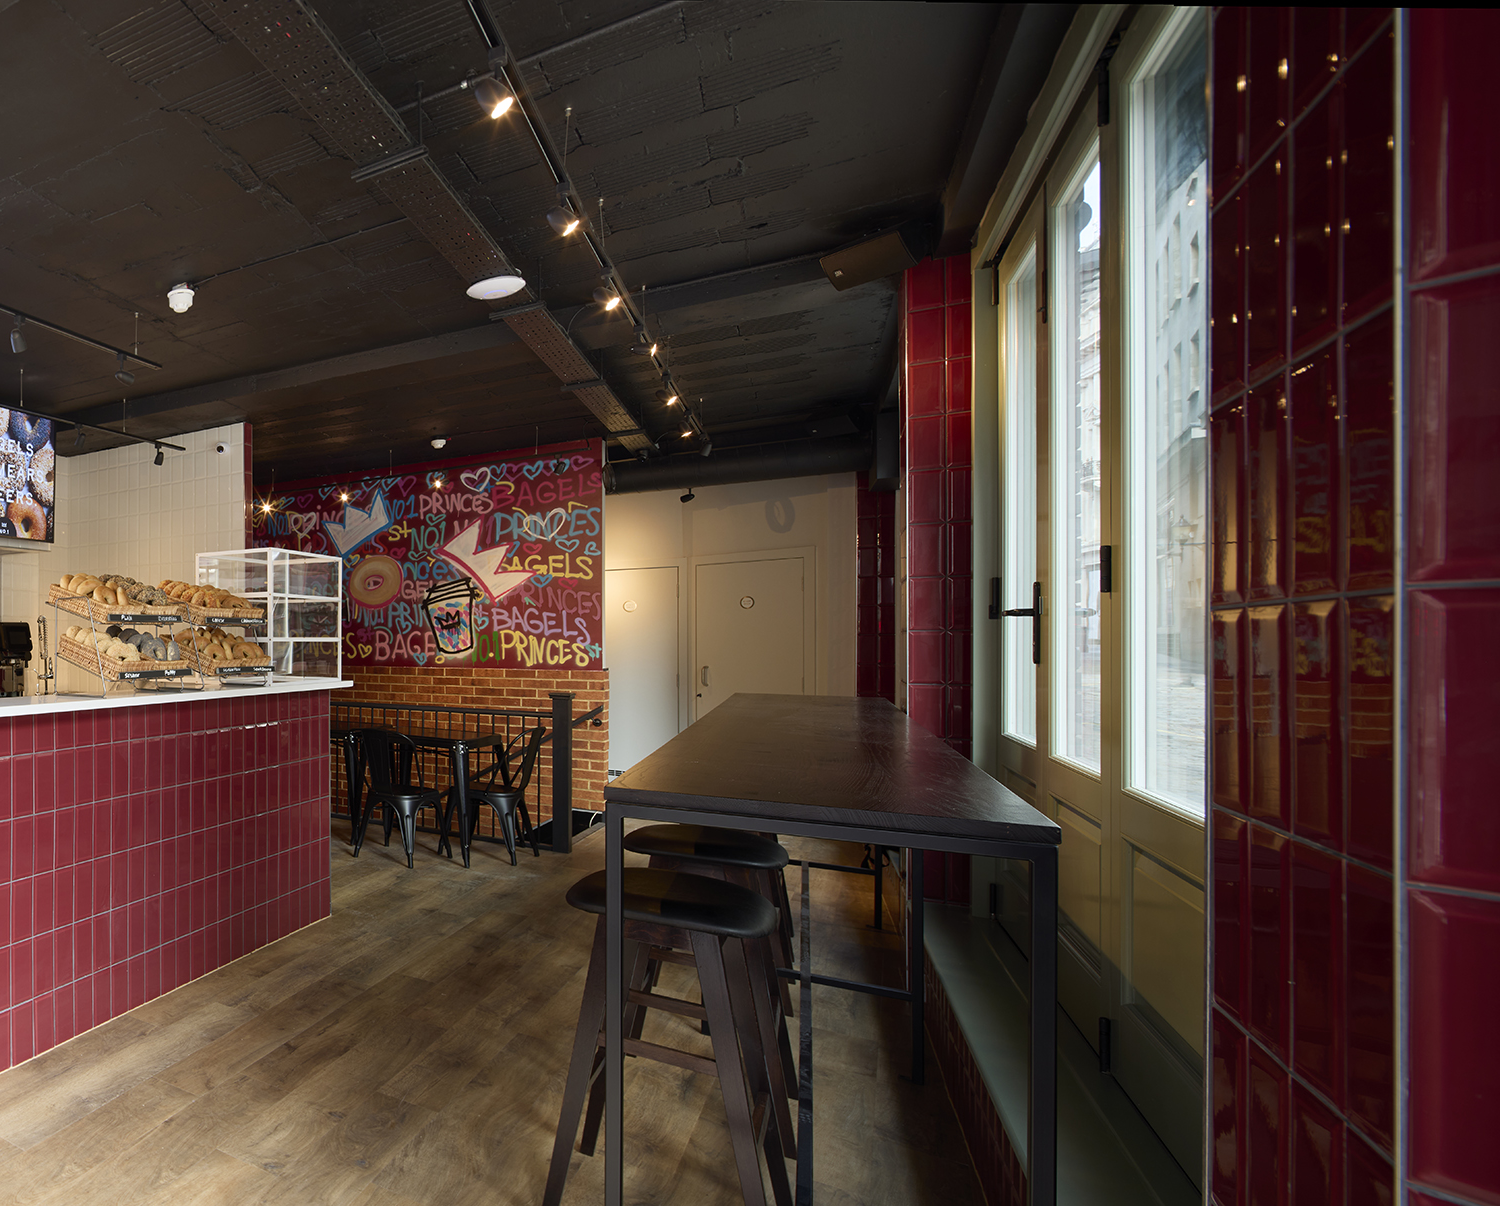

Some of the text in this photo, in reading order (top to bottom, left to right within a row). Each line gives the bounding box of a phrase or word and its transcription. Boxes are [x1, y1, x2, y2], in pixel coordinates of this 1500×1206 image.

[419, 492, 494, 520] PRINCES
[492, 472, 602, 510] BAGELS
[494, 507, 601, 544] PRINCES
[491, 606, 591, 646] BAGELS
[500, 630, 590, 667] PRINCES
